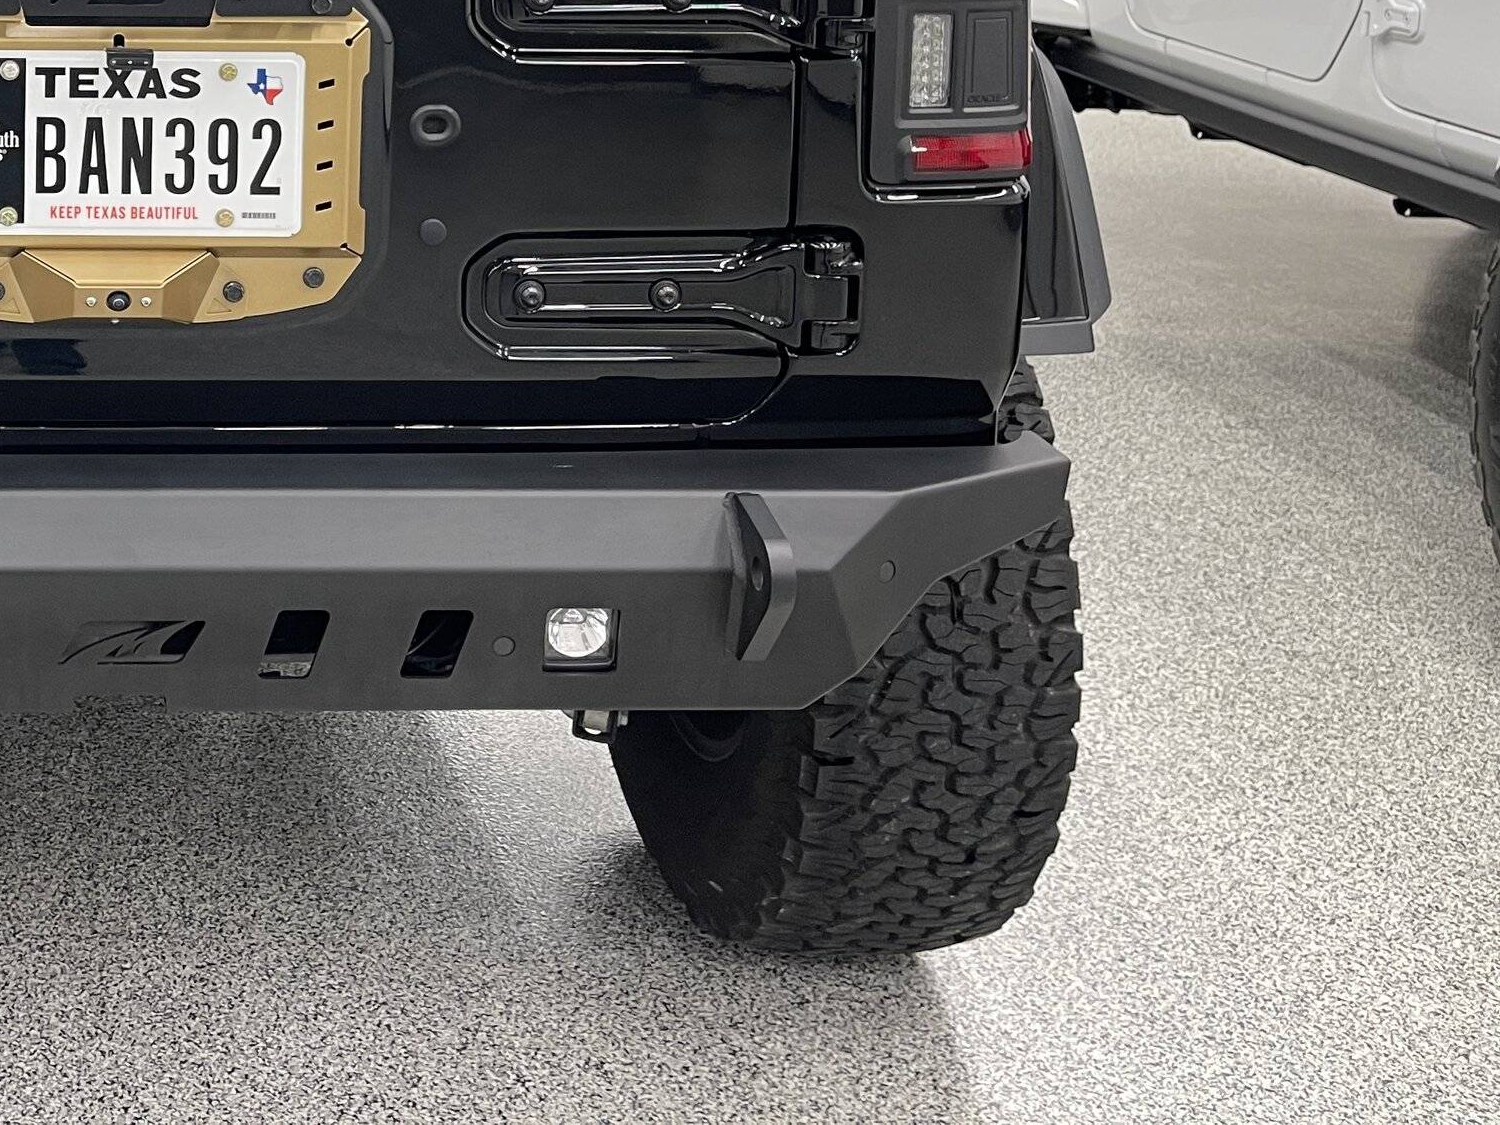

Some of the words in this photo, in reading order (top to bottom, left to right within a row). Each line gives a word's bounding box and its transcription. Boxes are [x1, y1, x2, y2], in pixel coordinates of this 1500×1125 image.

[35, 67, 202, 99] TEXAS
[36, 117, 282, 196] BAN392
[50, 206, 83, 220] KEEP
[87, 206, 126, 220] TEXAS
[131, 206, 199, 220] BEAUTIFUL
